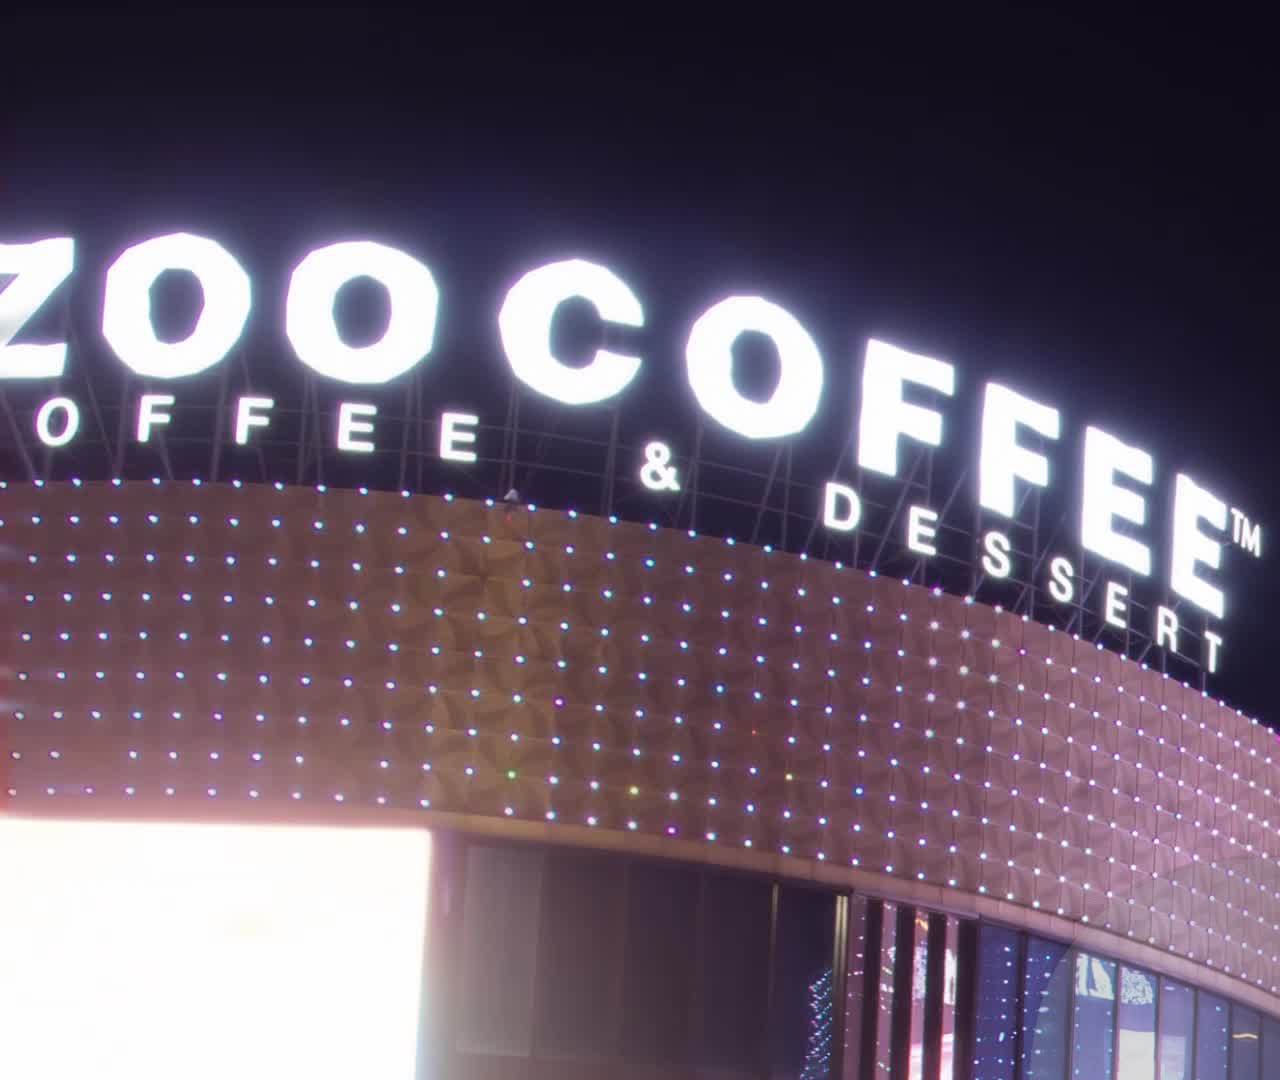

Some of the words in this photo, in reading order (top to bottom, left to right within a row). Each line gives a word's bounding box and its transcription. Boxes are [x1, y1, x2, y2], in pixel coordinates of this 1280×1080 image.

[0, 232, 440, 384] ZOO
[499, 258, 1227, 617] COFFEE
[640, 441, 681, 492] &
[823, 482, 1222, 674] DESSERT
